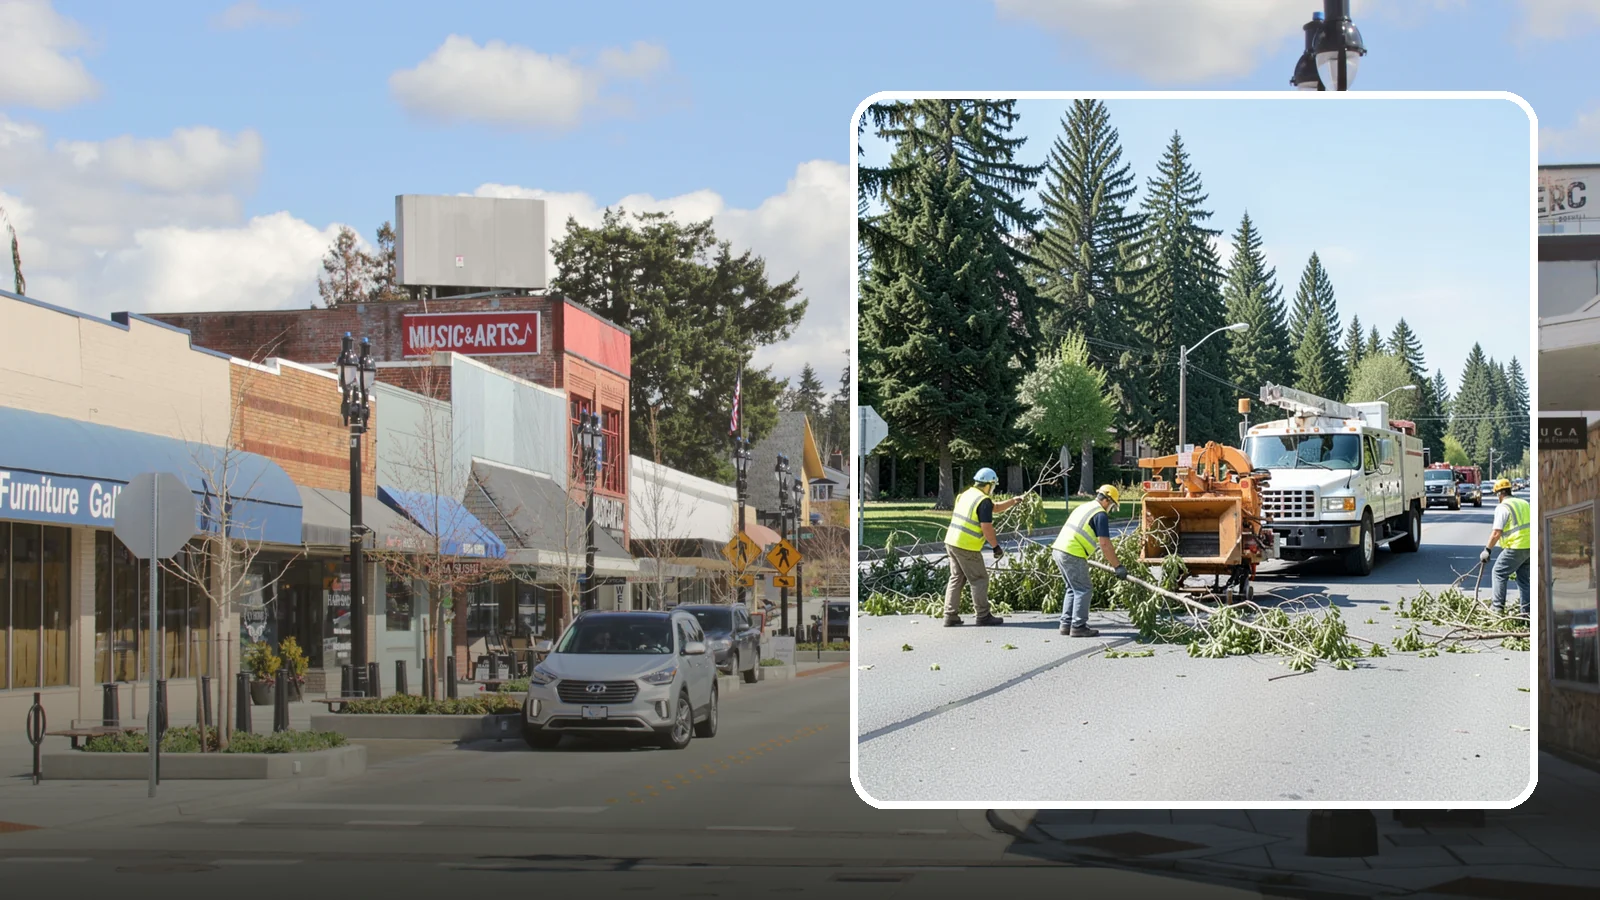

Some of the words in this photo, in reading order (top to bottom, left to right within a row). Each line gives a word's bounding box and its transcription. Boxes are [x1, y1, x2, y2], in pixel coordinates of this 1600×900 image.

[409, 323, 519, 348] MUSIC&ARTS
[1540, 427, 1577, 437] UGA
[0, 471, 79, 515] Furniture
[89, 482, 121, 519] Gal
[453, 564, 480, 575] SUSHI
